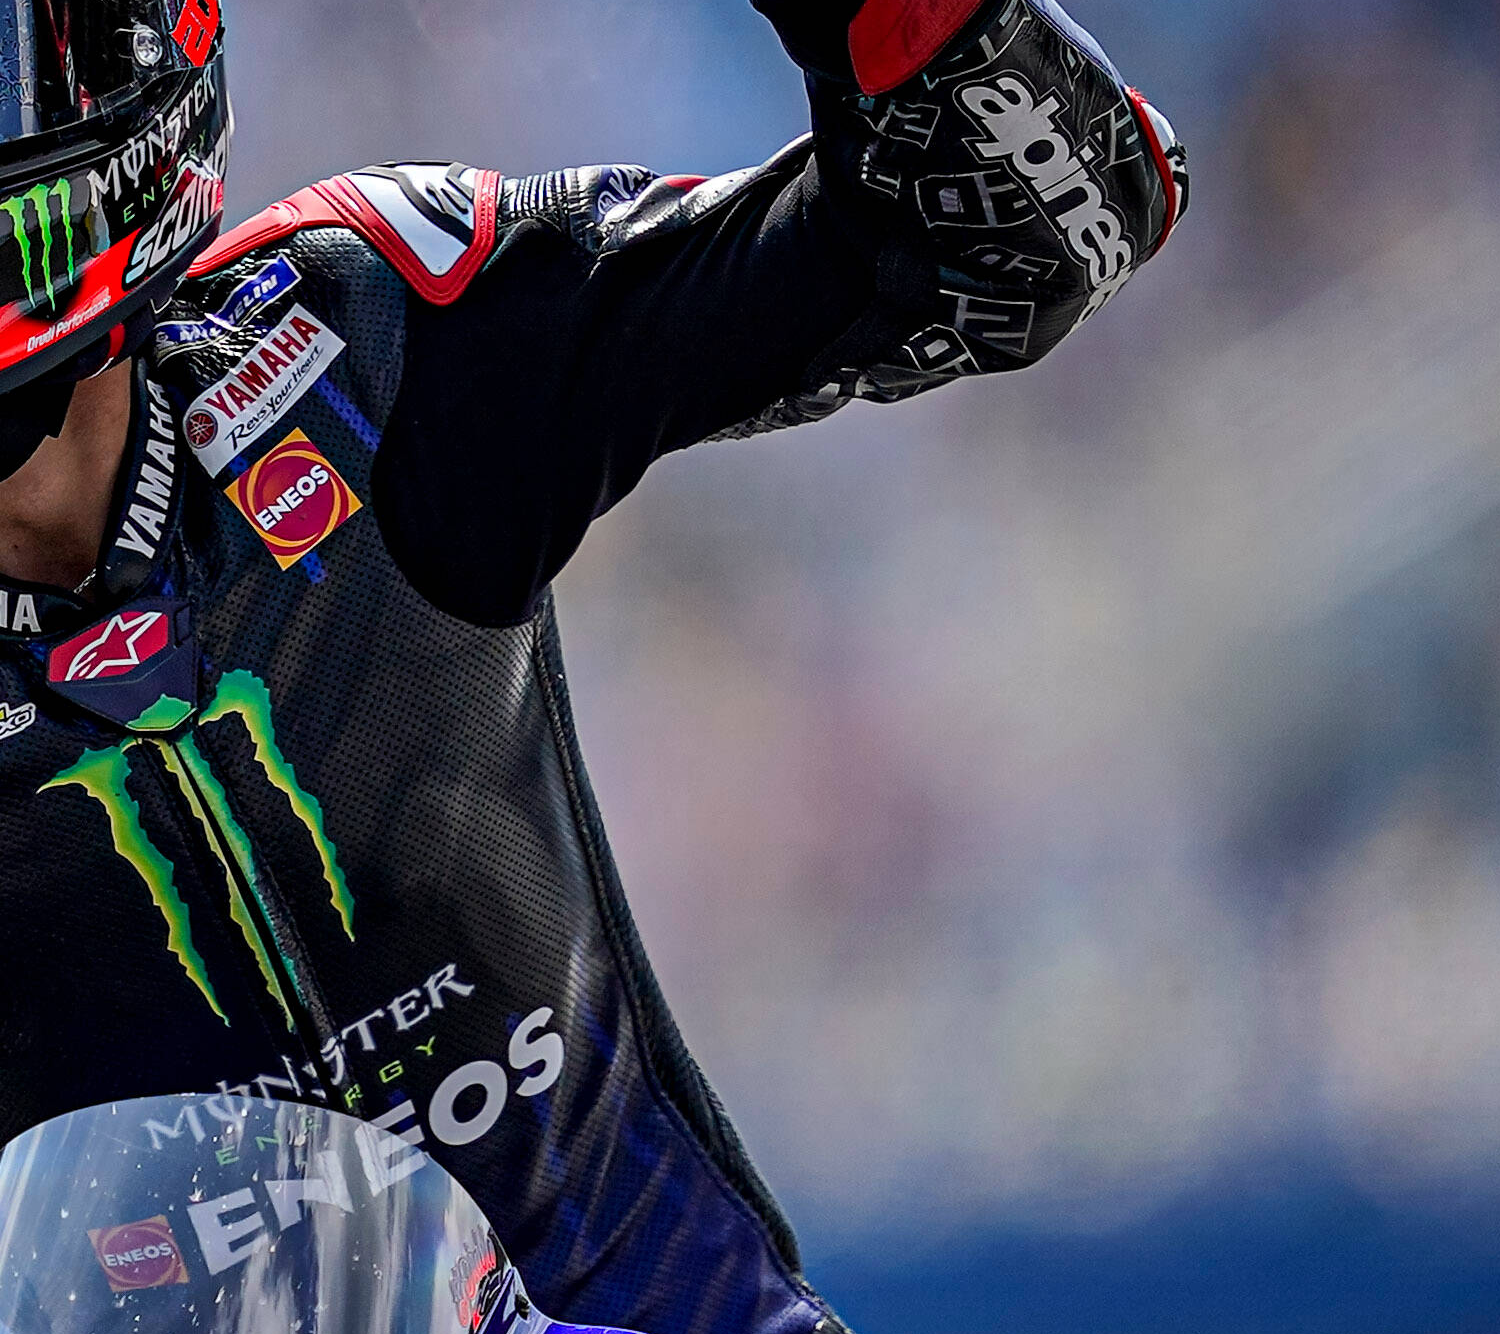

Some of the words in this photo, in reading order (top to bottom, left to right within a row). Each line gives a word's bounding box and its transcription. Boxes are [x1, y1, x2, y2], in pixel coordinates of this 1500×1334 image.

[204, 315, 322, 421] YAMAHA
[224, 408, 268, 451] Revs
[265, 378, 293, 417] Your
[291, 345, 320, 383] Heart
[115, 378, 176, 560] YAMAHA
[254, 464, 331, 532] ENEOS
[139, 961, 476, 1153] MONSTER
[186, 1006, 565, 1277] ENEOS
[103, 1243, 174, 1269] ENEOS
